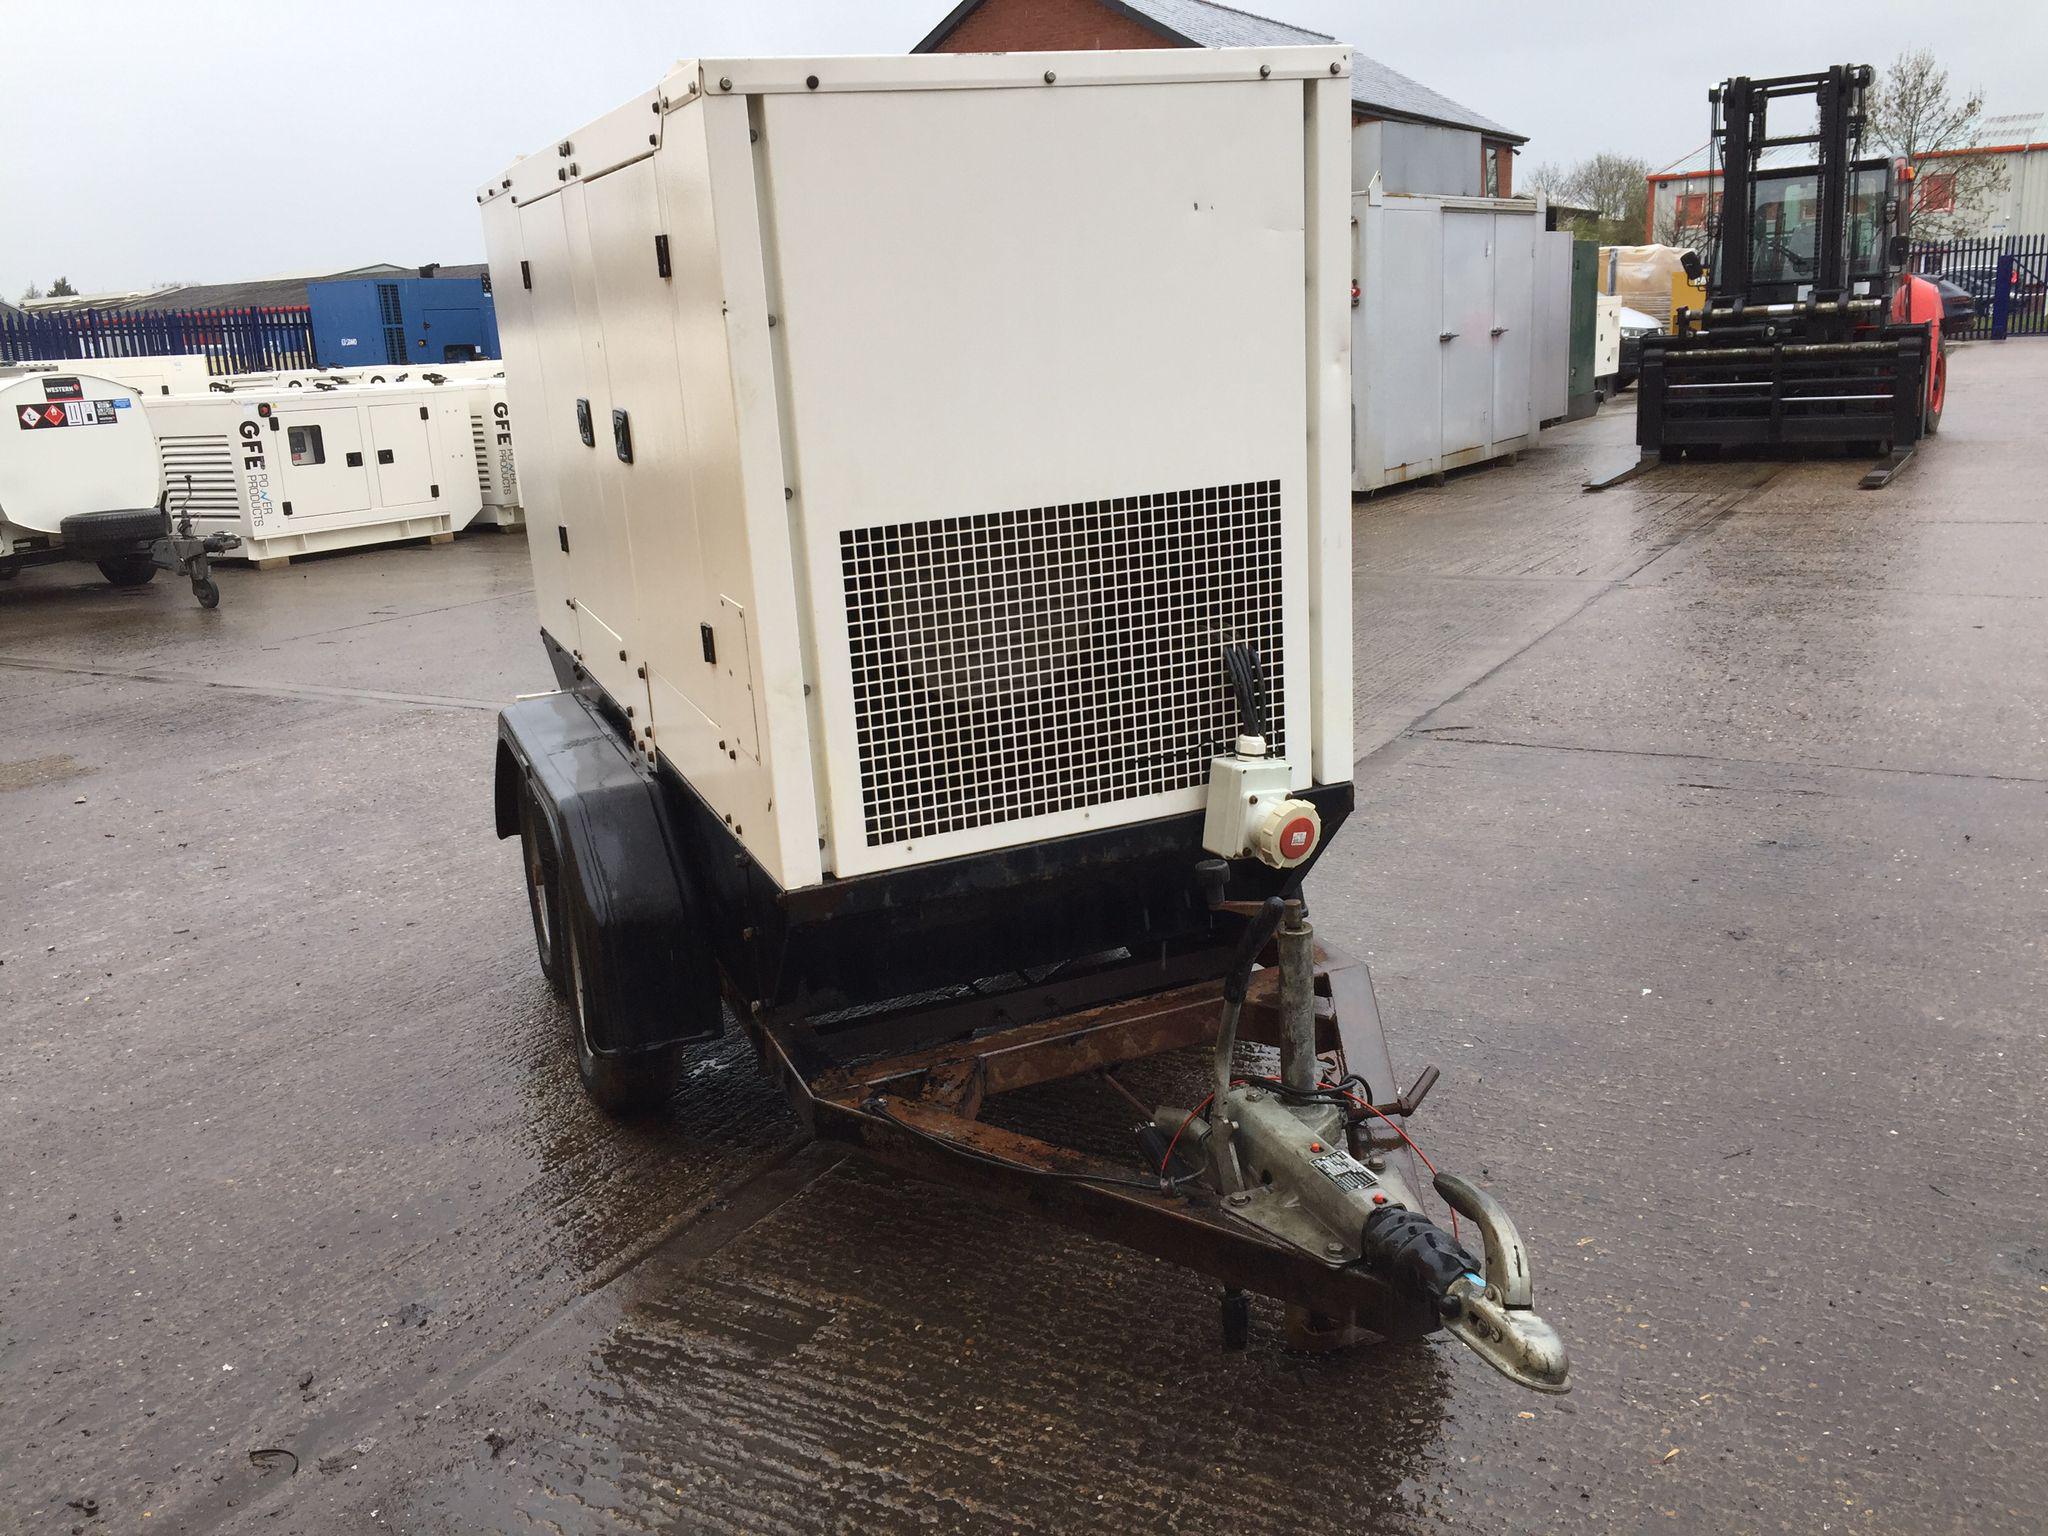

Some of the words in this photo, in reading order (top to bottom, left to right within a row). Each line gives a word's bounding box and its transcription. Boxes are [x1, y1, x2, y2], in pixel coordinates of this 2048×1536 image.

[239, 420, 265, 470] GFE
[493, 402, 512, 446] GFE
[258, 473, 273, 515] POWER
[499, 449, 512, 496] PRODUCTS
[248, 474, 264, 527] PRODUCTS
